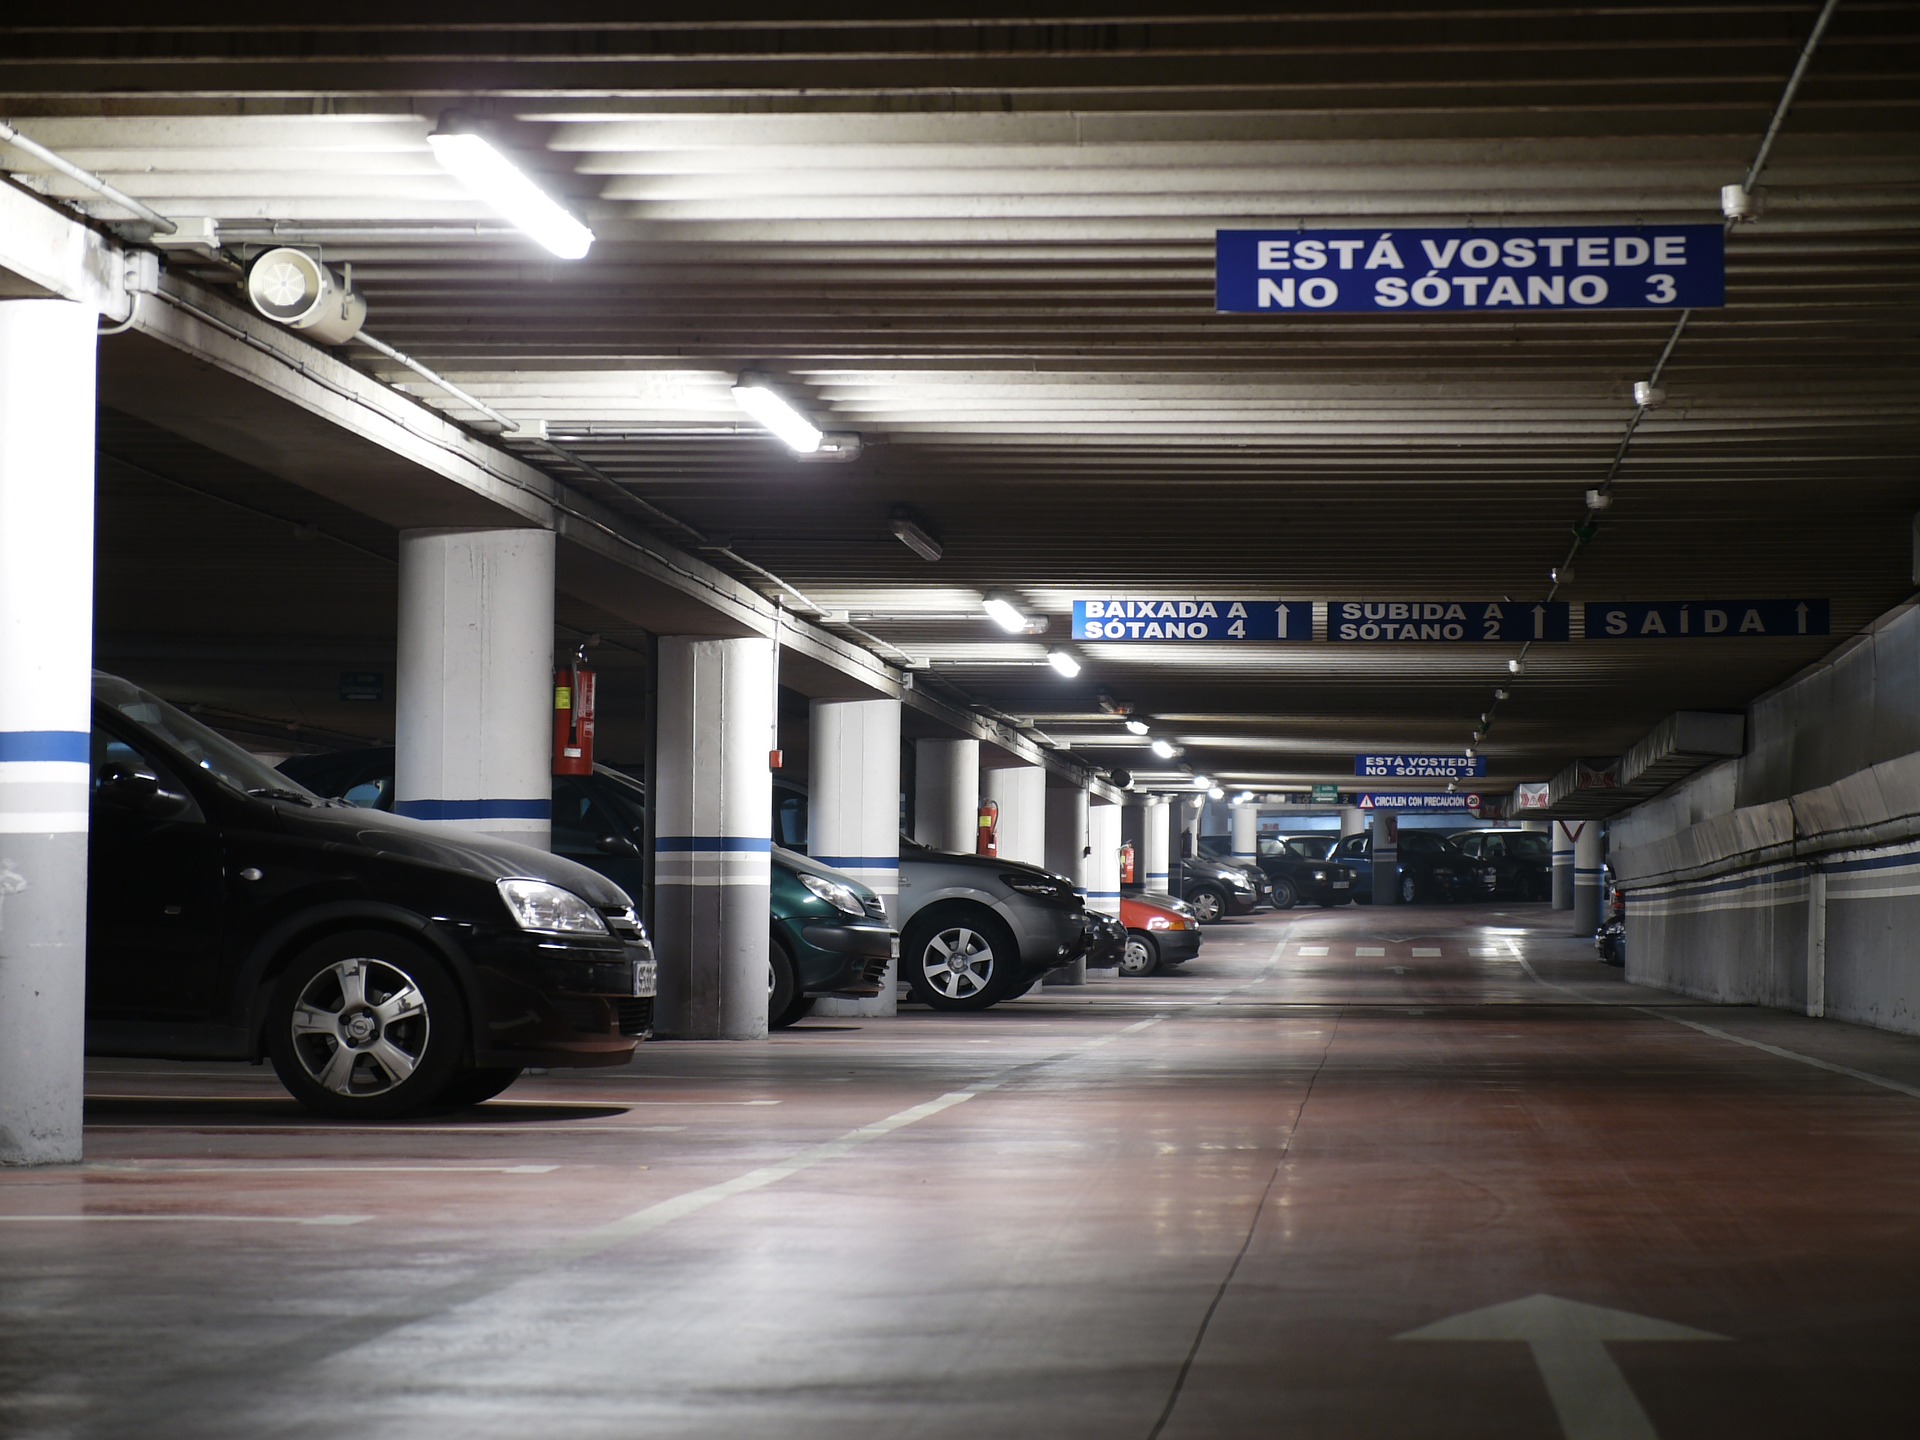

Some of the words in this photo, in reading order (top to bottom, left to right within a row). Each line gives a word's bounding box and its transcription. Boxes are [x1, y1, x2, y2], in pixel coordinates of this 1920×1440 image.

[1257, 233, 1404, 270] ESTÁ
[1421, 236, 1687, 268] VOSTEDE
[1257, 277, 1338, 307] NO
[1374, 270, 1609, 307] SÓTANO
[1645, 274, 1677, 304] 3
[1085, 601, 1218, 618] BAIXADA
[1227, 602, 1248, 618] A
[1342, 603, 1467, 620] SUBIDA
[1483, 603, 1504, 619] A
[1605, 604, 1766, 635] SAÍDA
[1084, 618, 1208, 639] SÓTANO
[1227, 619, 1246, 639] 4
[1339, 619, 1464, 640] SÓTANO
[1483, 620, 1501, 640] 2
[1366, 756, 1404, 766] ESTÁ
[1408, 757, 1477, 767] VOSTEDE
[1365, 767, 1387, 776] NO
[1396, 766, 1457, 776] SÓTANO
[1465, 768, 1475, 777] 3
[1374, 796, 1406, 807] CIRCULEN
[1408, 796, 1422, 807] CON
[1423, 795, 1465, 807] PRECAUCIÓN
[1468, 796, 1478, 805] 20
